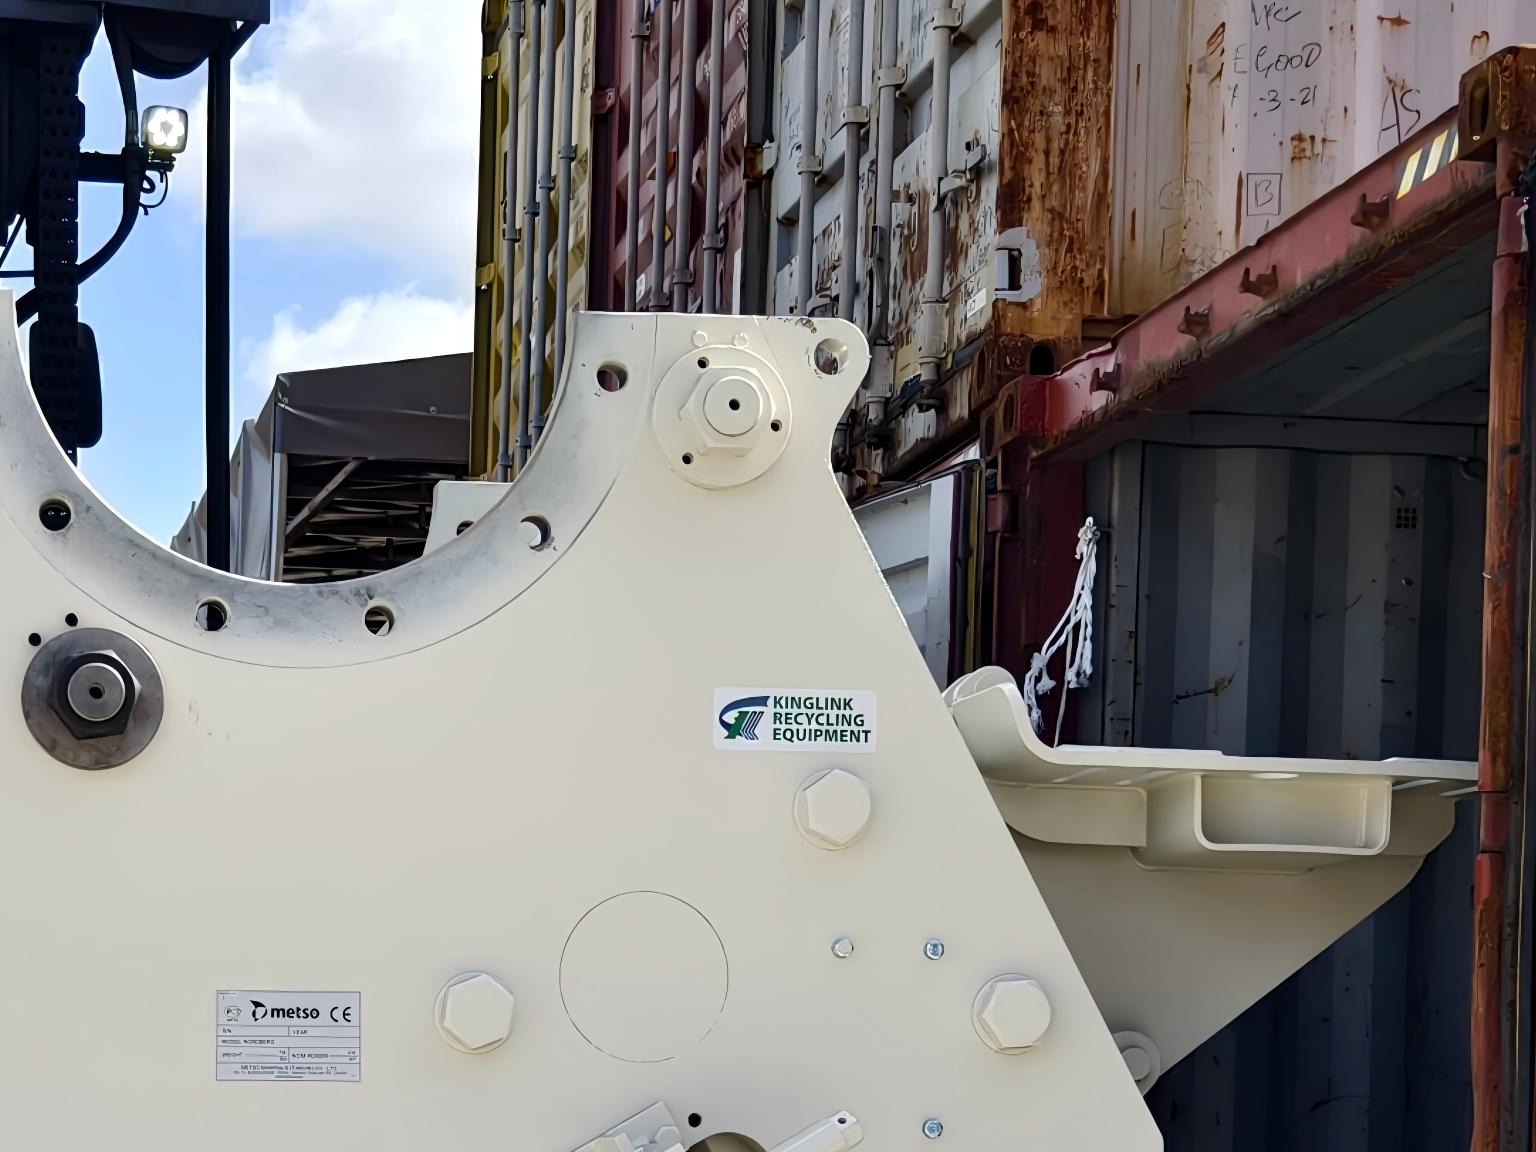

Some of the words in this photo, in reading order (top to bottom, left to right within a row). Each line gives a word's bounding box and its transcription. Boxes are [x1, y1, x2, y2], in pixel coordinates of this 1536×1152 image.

[1255, 42, 1322, 78] GOOD
[773, 695, 854, 711] KINGLINK
[773, 712, 865, 727] RECYCLING
[772, 728, 872, 744] EQUIPMENT
[270, 1006, 320, 1019] metso
